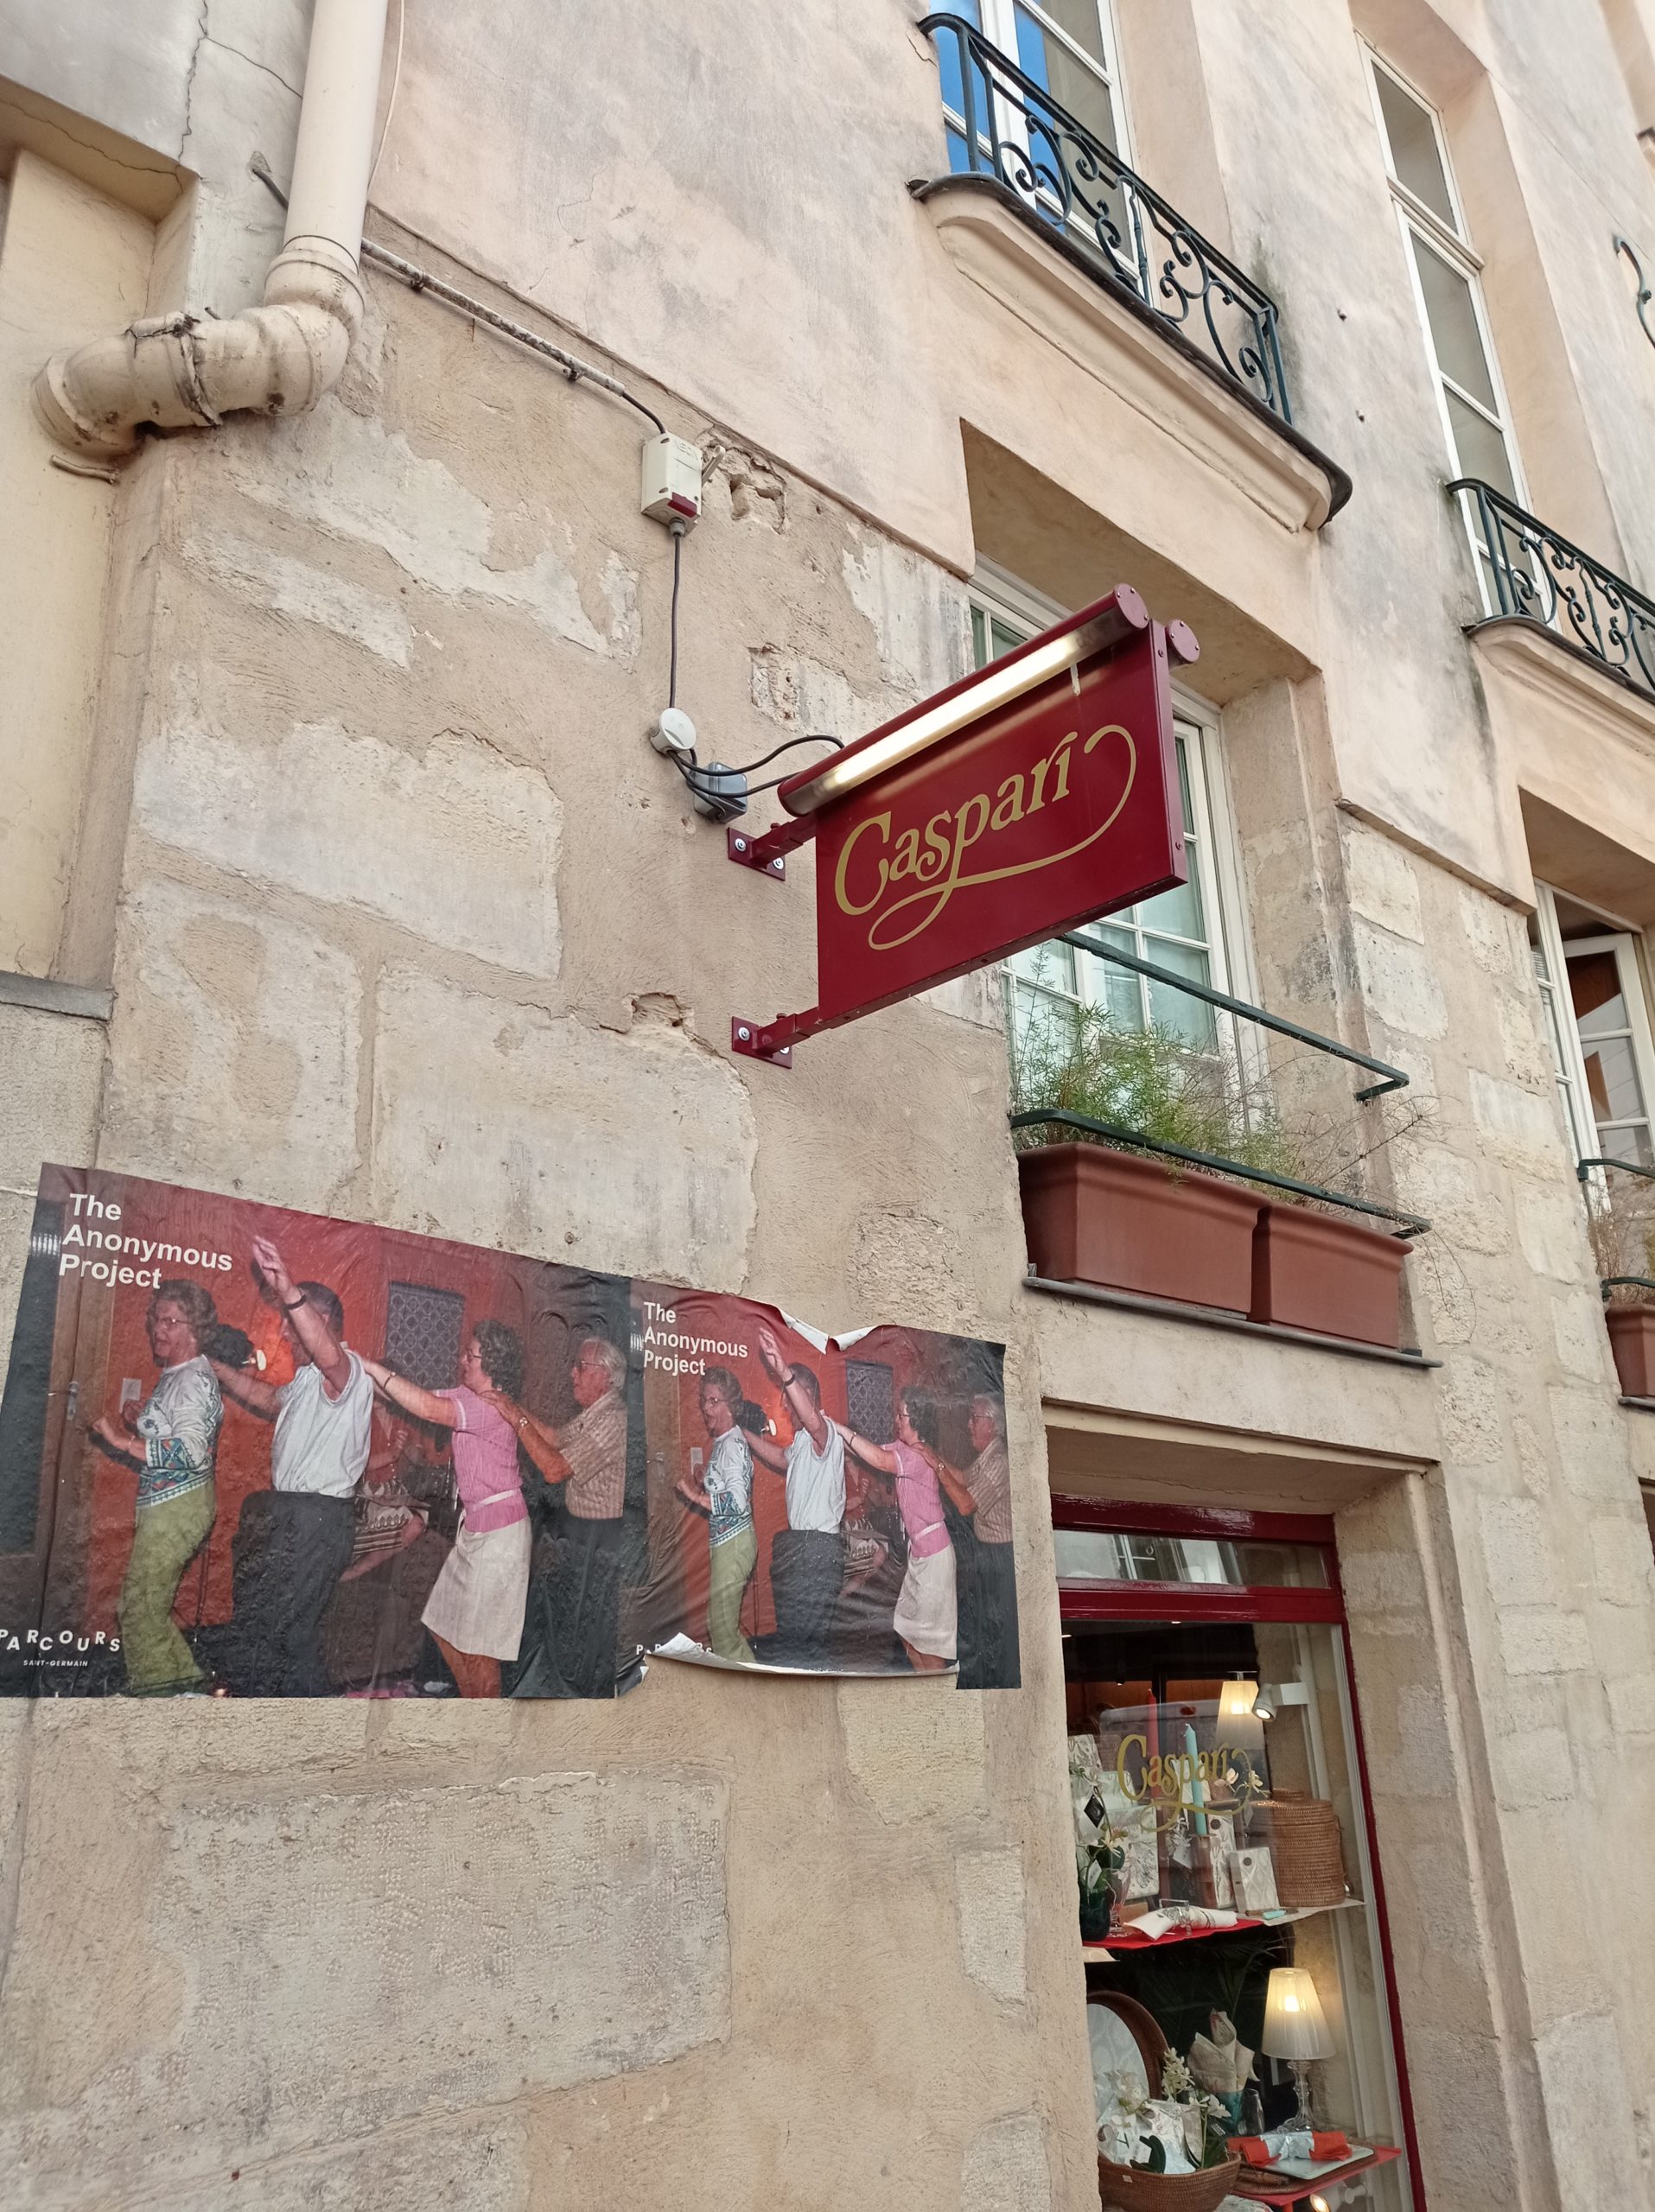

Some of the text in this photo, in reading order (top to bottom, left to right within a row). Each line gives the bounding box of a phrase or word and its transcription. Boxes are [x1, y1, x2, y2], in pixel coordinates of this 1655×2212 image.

[836, 725, 1136, 950] Caspari
[69, 1193, 122, 1221] The
[62, 1224, 233, 1271] Anonymous
[59, 1254, 162, 1289] Project
[644, 1301, 677, 1324] The
[644, 1325, 748, 1358] Anonymous
[644, 1350, 706, 1376] Project
[0, 1629, 121, 1652] PARCOURS
[1117, 1733, 1252, 1832] Caspari
